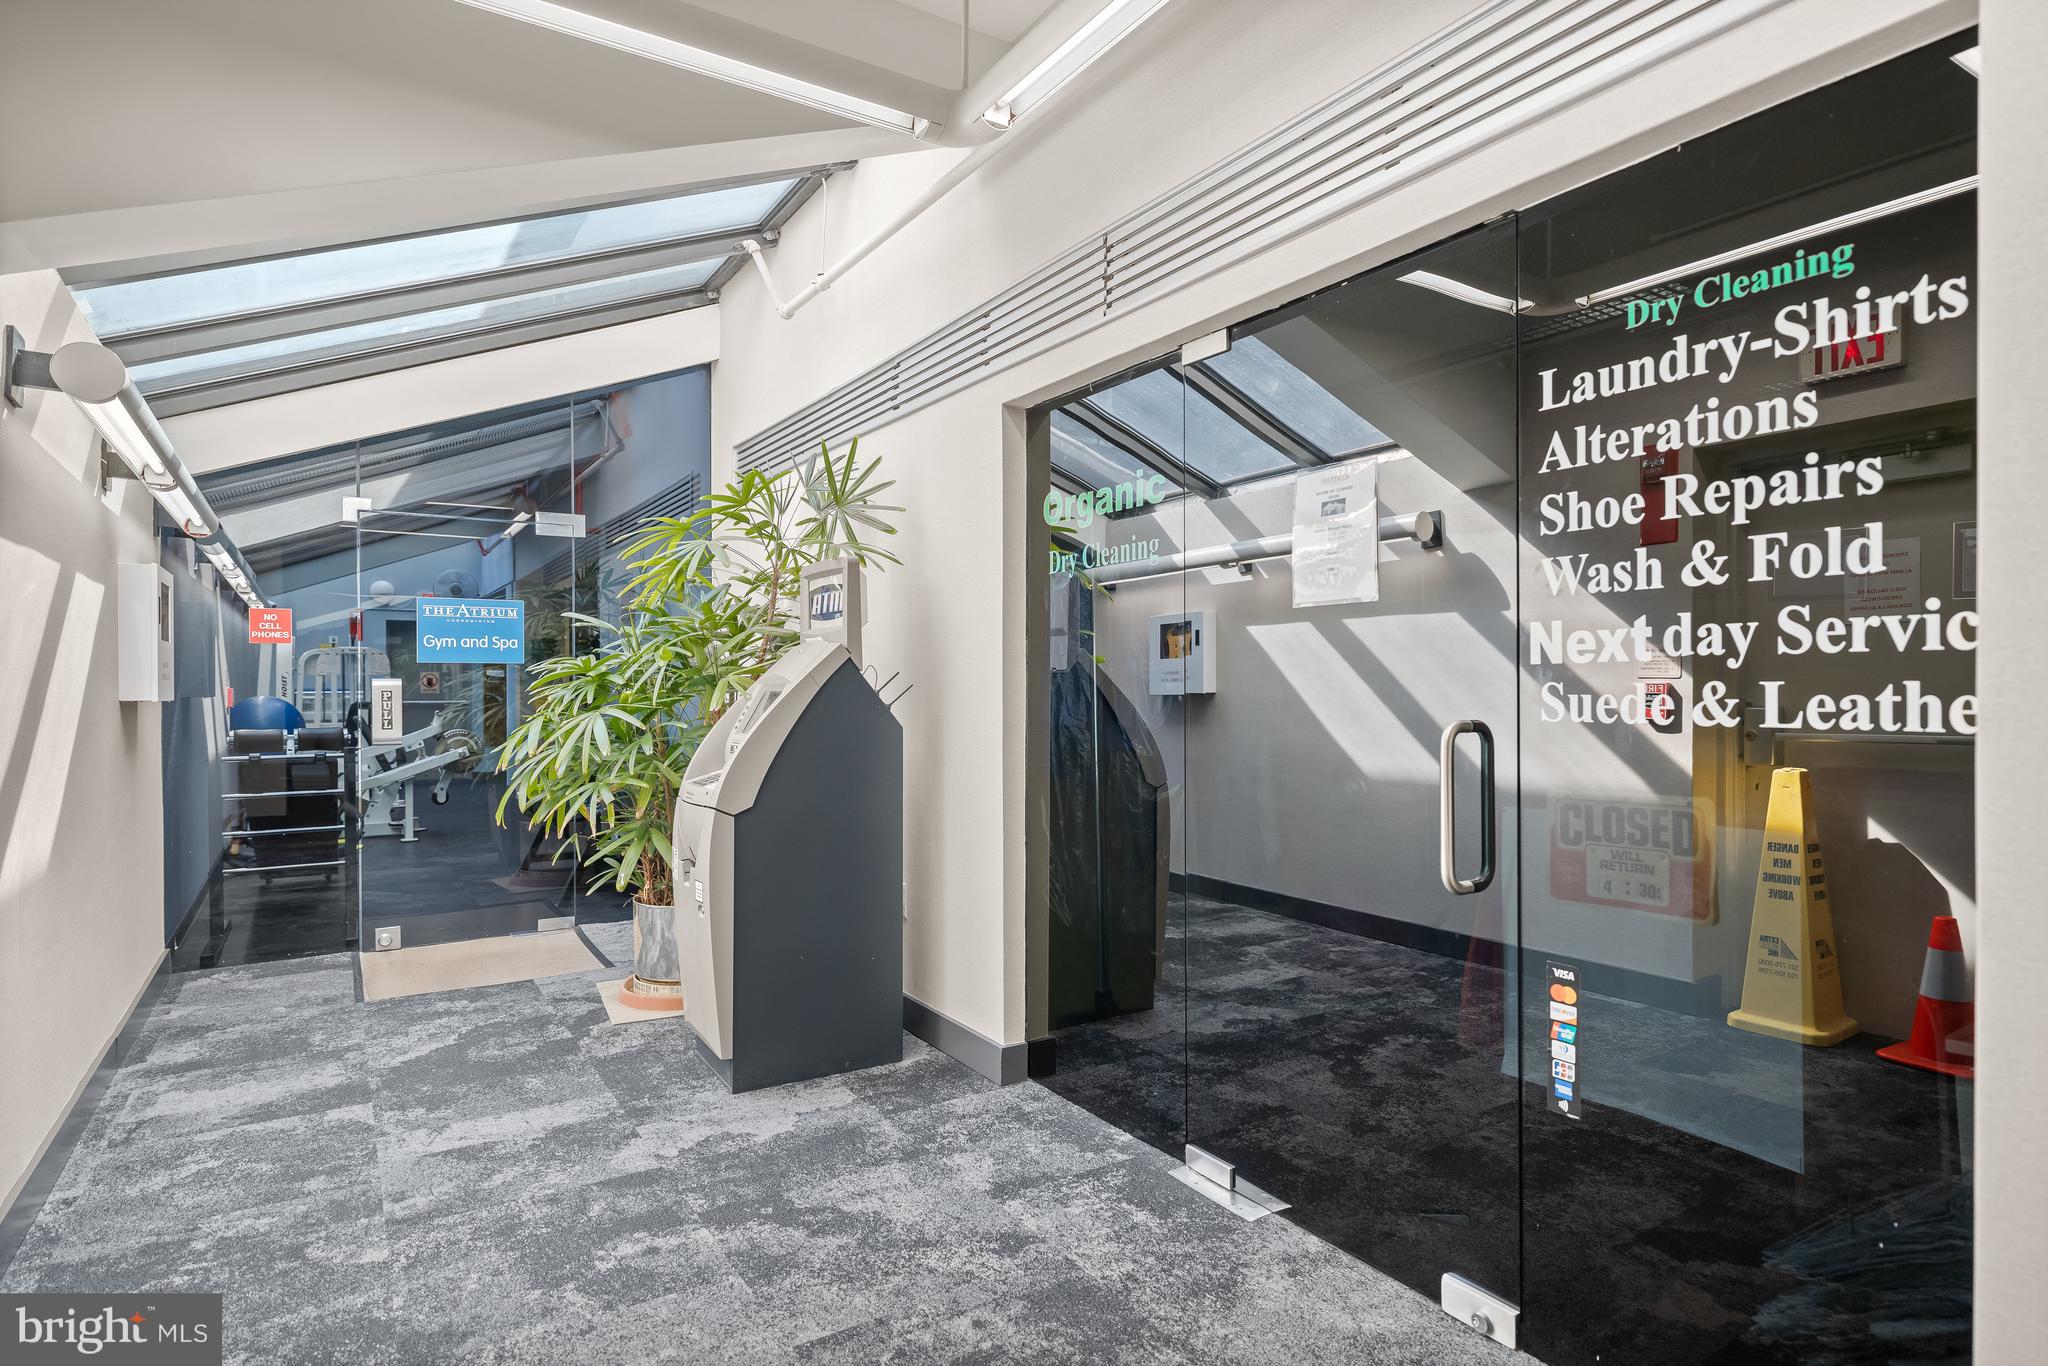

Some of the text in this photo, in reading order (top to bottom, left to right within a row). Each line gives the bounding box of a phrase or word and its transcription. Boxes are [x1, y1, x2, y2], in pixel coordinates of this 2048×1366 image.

[1625, 243, 1856, 331] Dry Cleaning
[1538, 274, 1970, 412] Laundry-Shirts
[1538, 389, 1819, 474] Alterations
[1043, 468, 1168, 528] Organic
[1540, 452, 1885, 537] Shoe Repairs
[1048, 535, 1160, 578] Dry Cleaning
[1541, 522, 1888, 597] Wash & Fold
[259, 622, 282, 630] CELL
[263, 613, 278, 621] NO
[423, 603, 517, 617] THE ATRIUM
[251, 631, 290, 639] PHONES
[423, 634, 518, 652] Gym and Spa
[1530, 614, 1653, 665] Next
[1663, 612, 1759, 669] day
[382, 691, 392, 730] PULL
[1540, 680, 1978, 735] Suede & Leathe
[1559, 802, 1699, 858] CLOSED
[1600, 860, 1656, 876] RETURN
[1610, 850, 1645, 862] WILL
[1552, 967, 1575, 981] VISA
